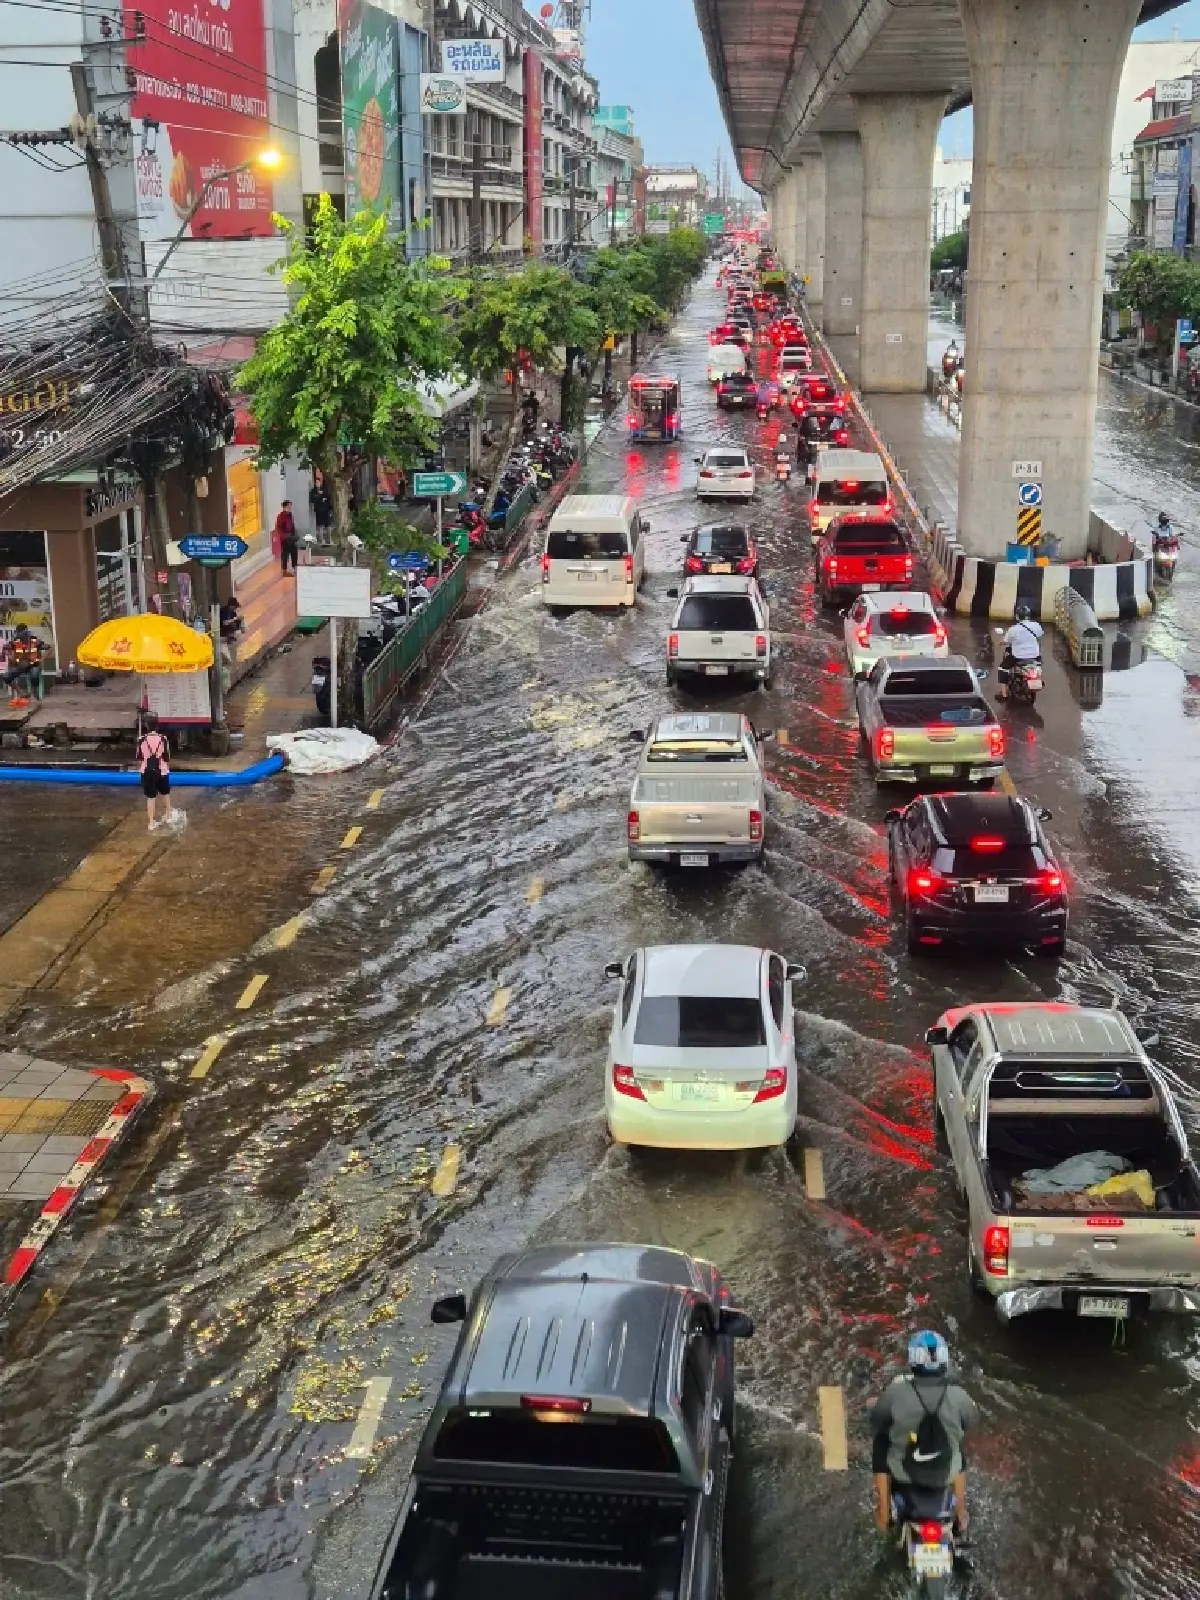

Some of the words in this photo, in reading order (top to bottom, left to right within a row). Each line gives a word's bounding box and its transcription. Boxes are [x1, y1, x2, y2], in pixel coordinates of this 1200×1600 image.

[452, 52, 501, 71] รถยนต์
[224, 540, 238, 553] 52
